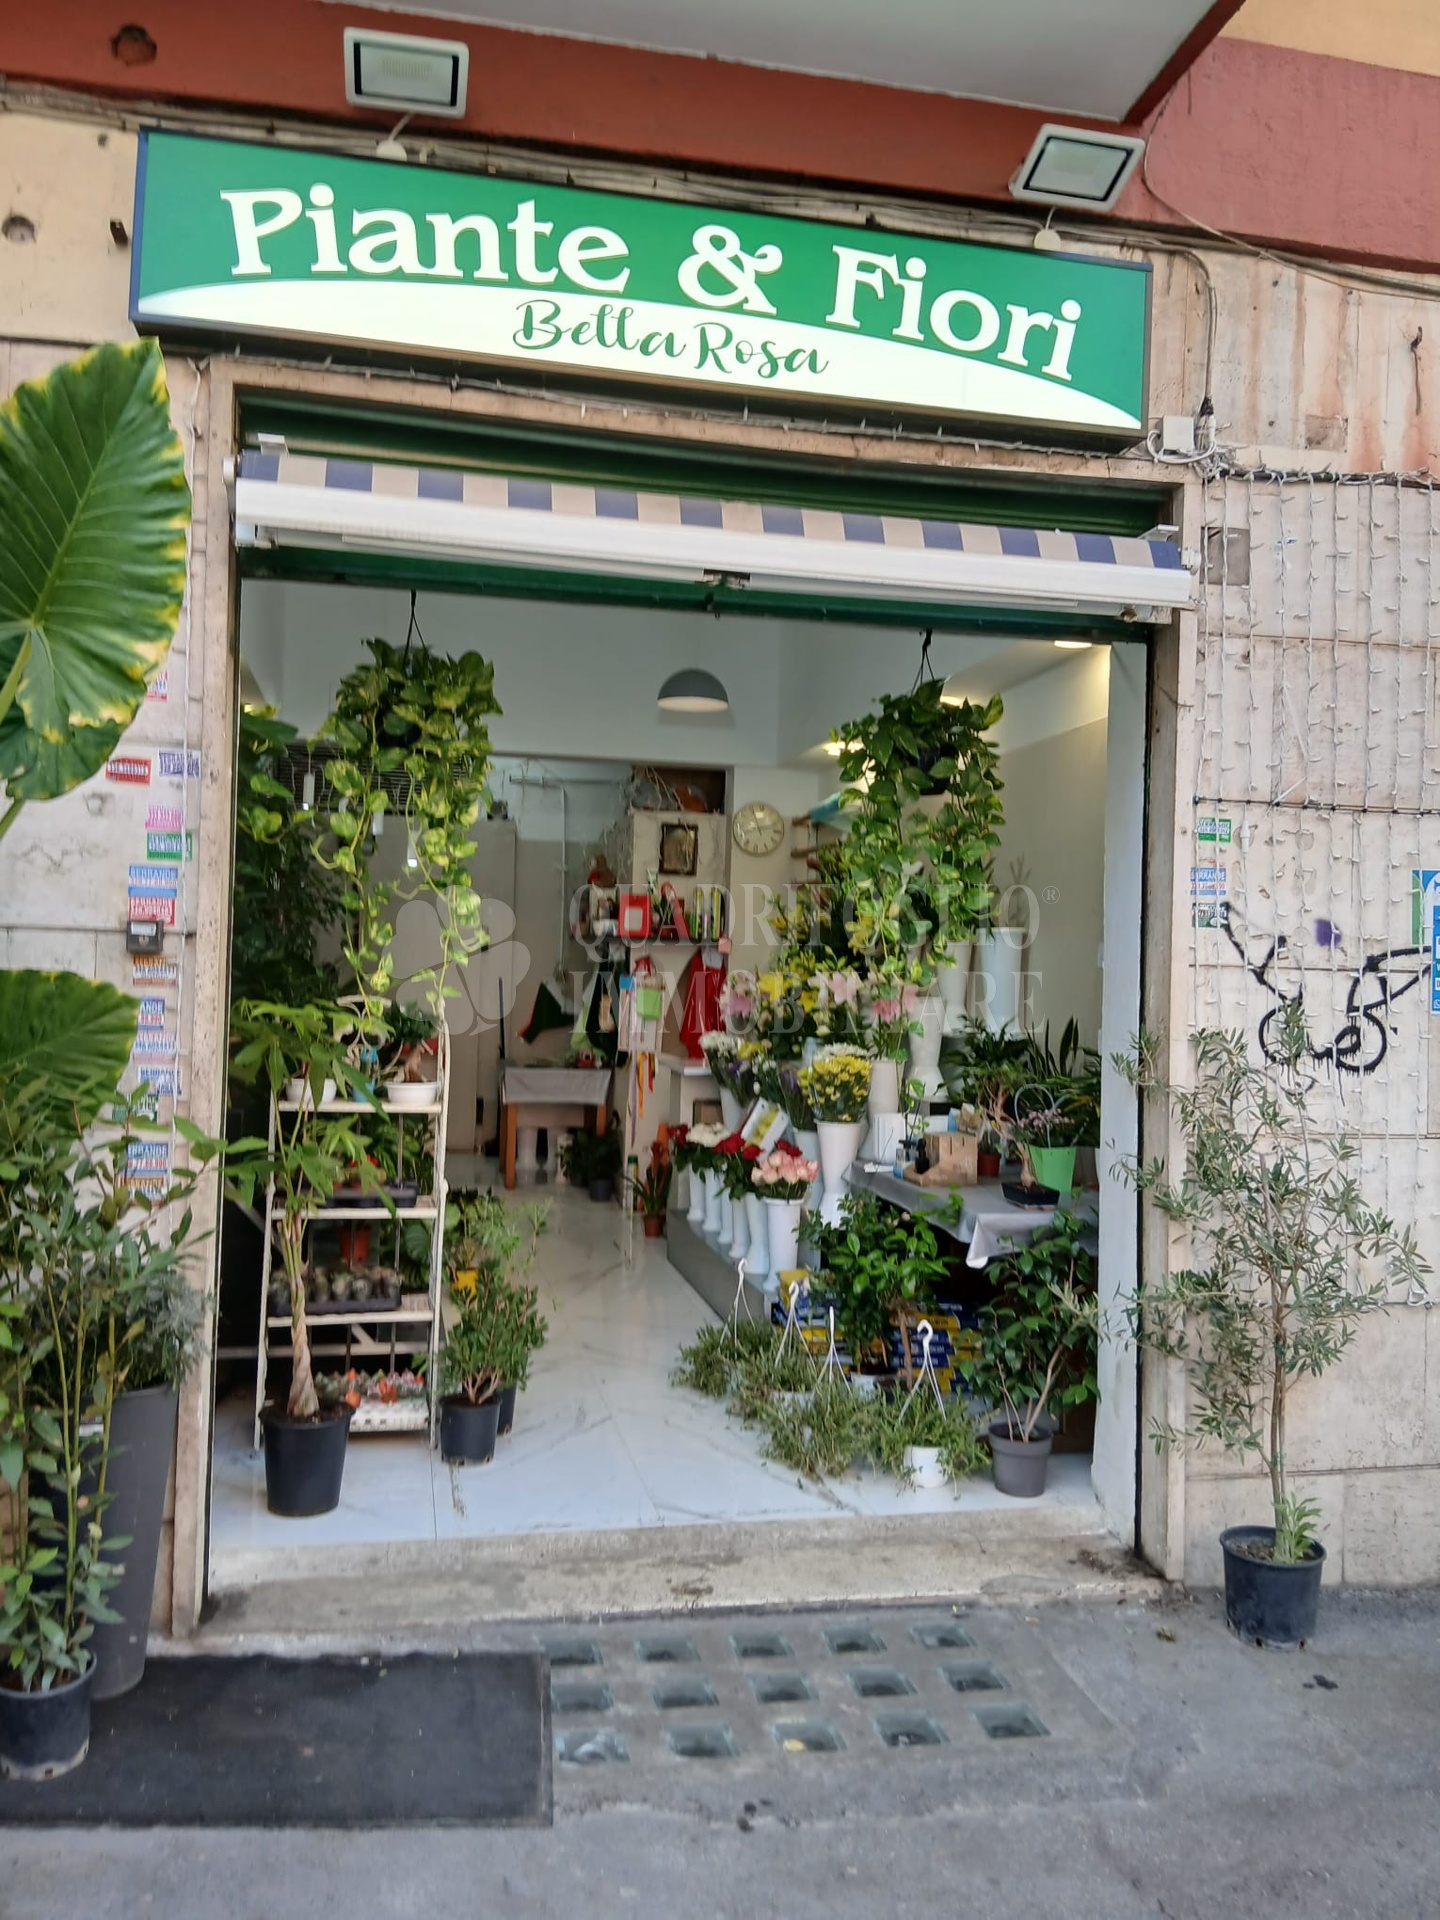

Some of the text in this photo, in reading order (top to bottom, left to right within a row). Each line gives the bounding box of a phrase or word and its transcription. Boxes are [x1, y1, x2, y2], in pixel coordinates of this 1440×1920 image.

[220, 183, 1083, 383] Piante & Fiori
[512, 299, 830, 379] Bella Rosa
